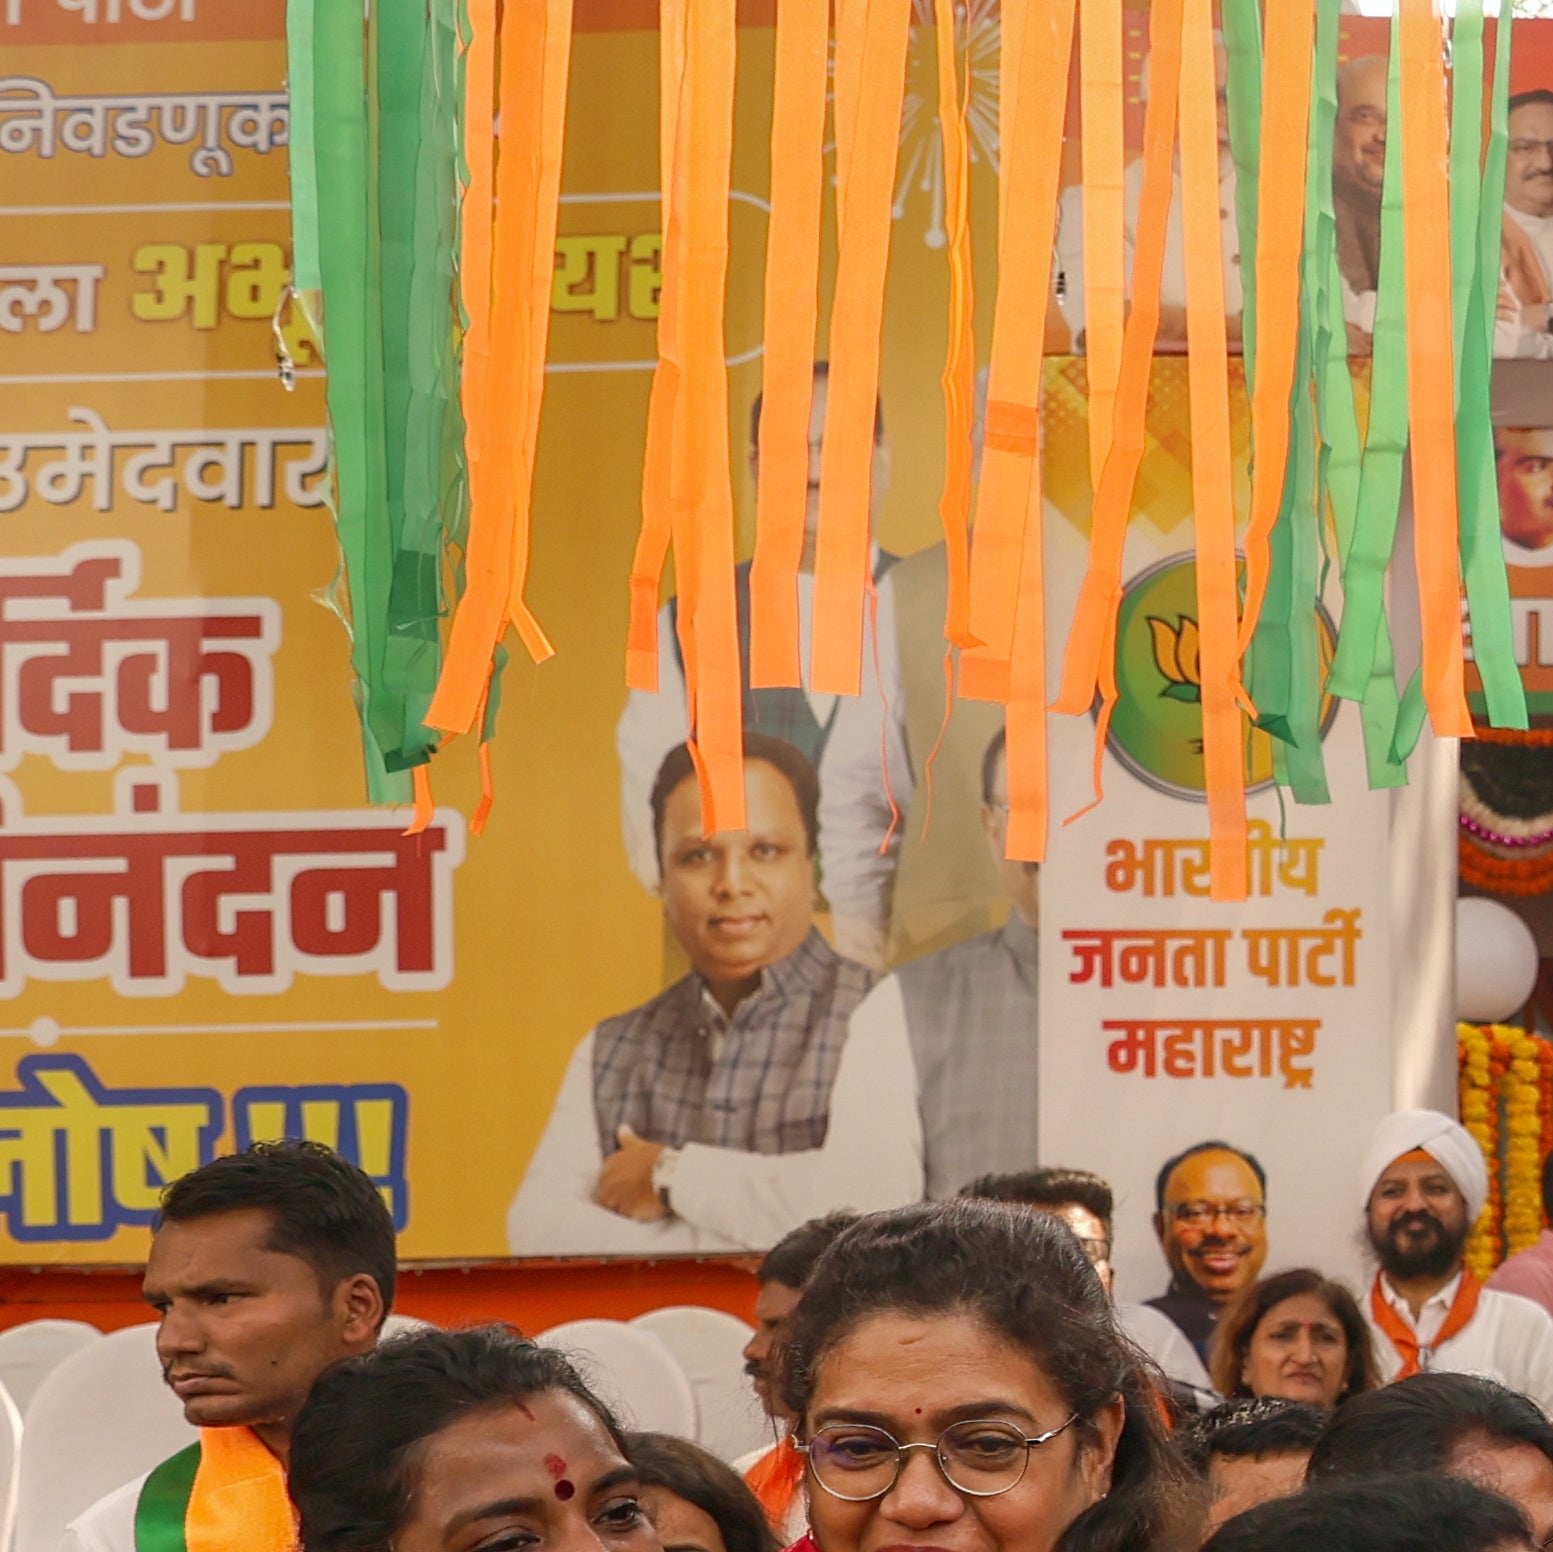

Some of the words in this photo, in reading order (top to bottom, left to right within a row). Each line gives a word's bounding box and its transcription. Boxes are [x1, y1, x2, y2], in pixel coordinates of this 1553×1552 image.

[1105, 818, 1325, 897] भारीय
[1061, 929, 1232, 988] जनता
[1241, 908, 1362, 987] पार्टी
[1102, 1019, 1322, 1089] महाराष्ट्र
